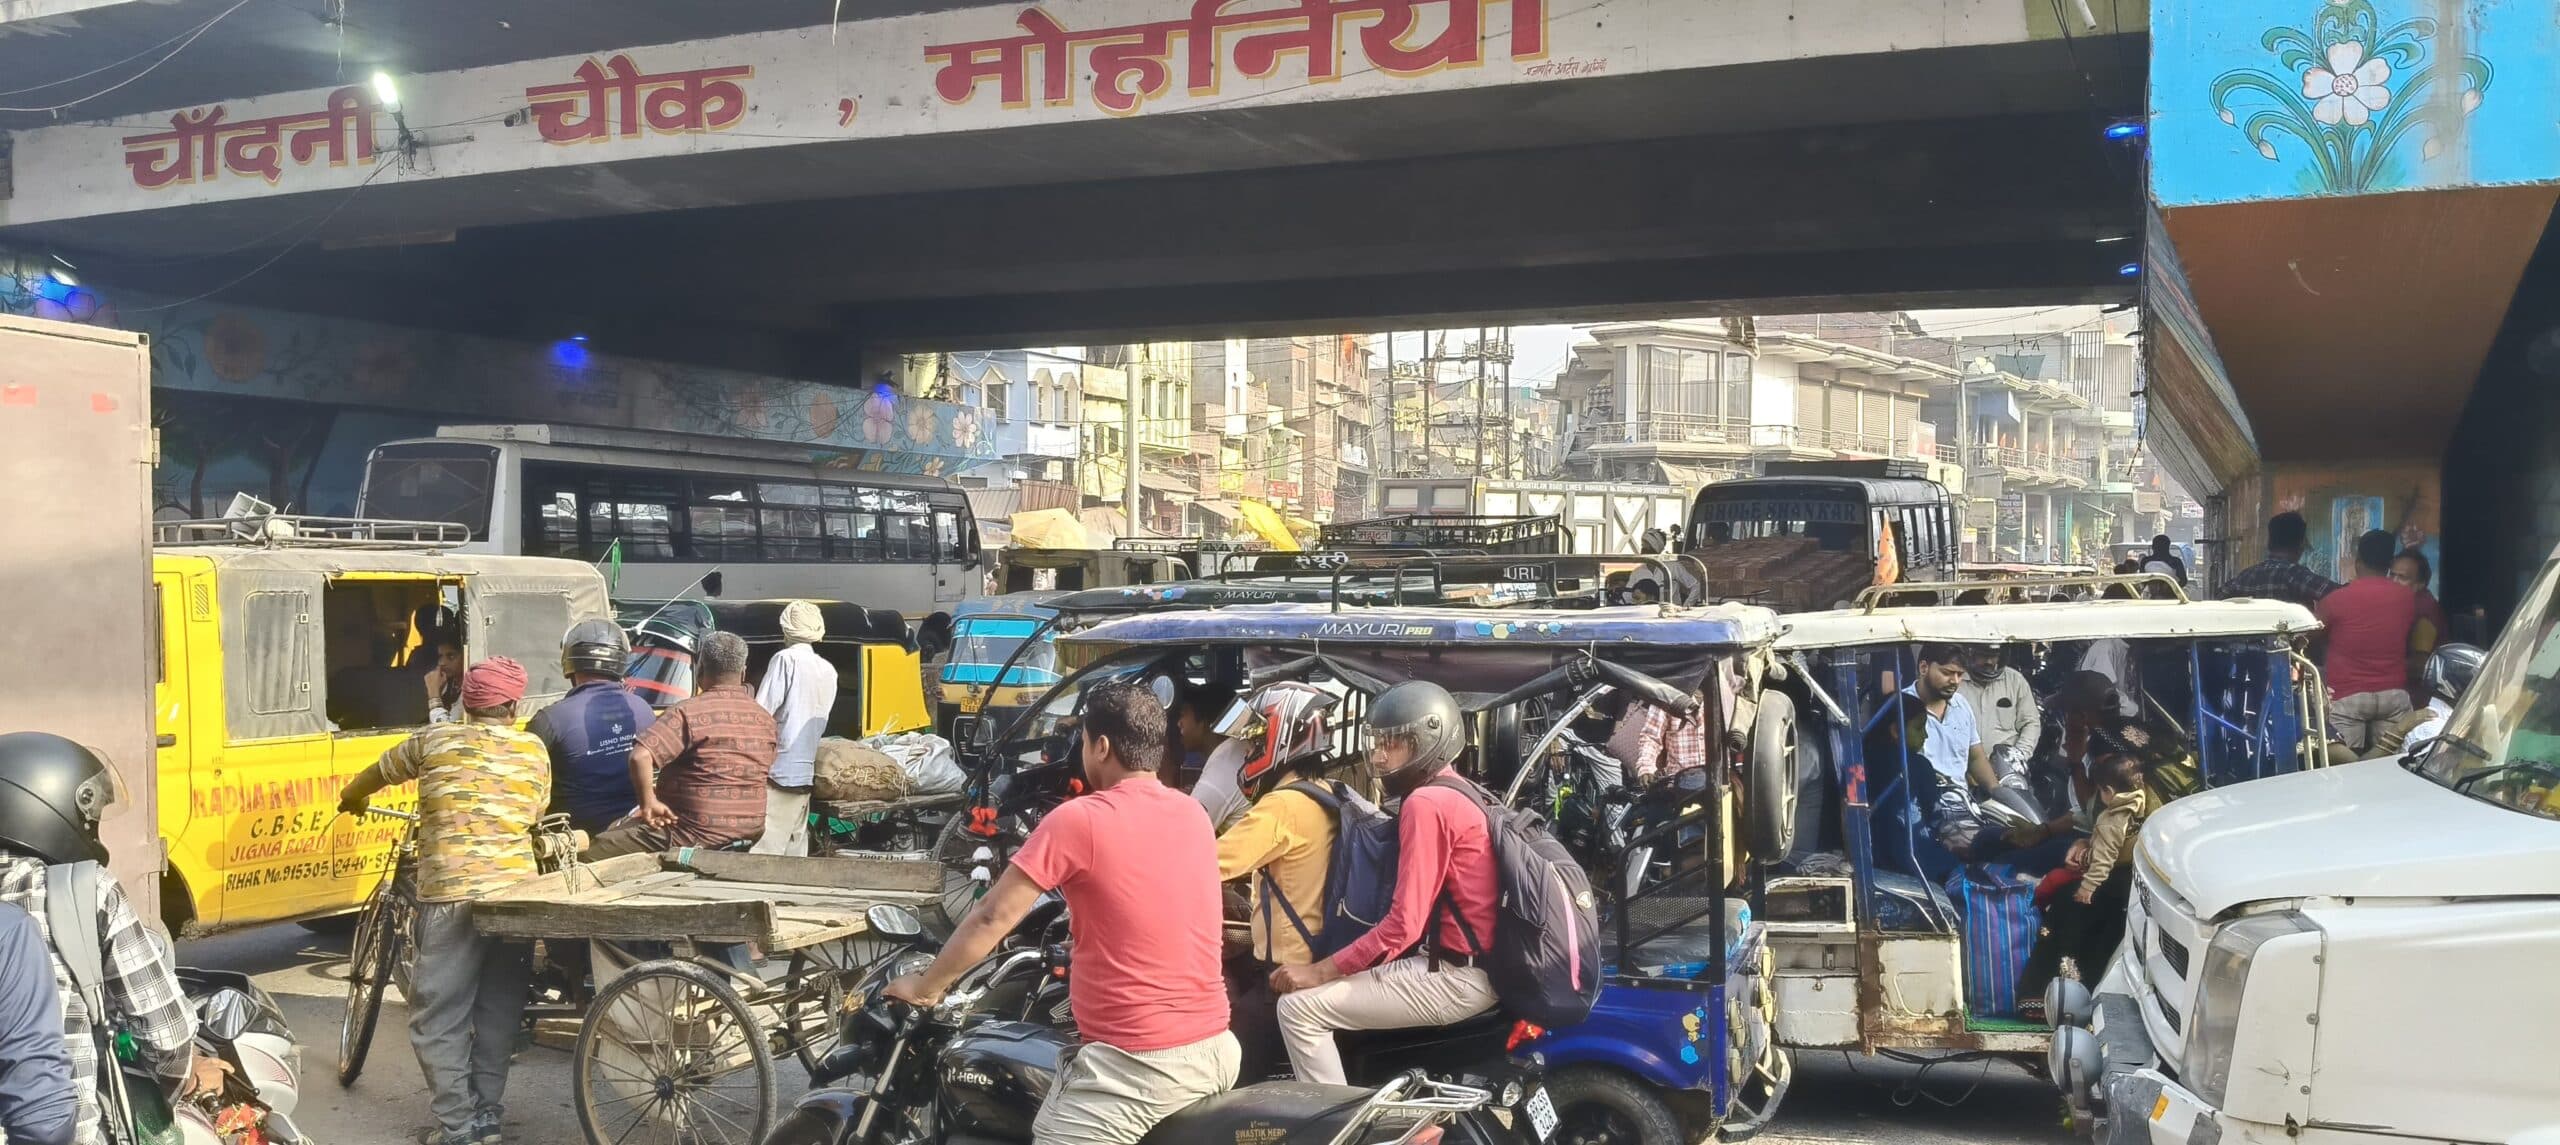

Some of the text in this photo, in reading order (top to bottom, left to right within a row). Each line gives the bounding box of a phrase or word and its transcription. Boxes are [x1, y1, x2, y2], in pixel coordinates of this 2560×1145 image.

[526, 53, 755, 146] चौक
[1704, 502, 1857, 522] BHOLE SHANKAR
[1223, 591, 1278, 600] MAYURI
[1317, 623, 1435, 636] MAYURI PRO
[229, 840, 282, 863] JIGNA
[225, 869, 261, 892] BIHAR
[957, 1070, 988, 1086] Hero
